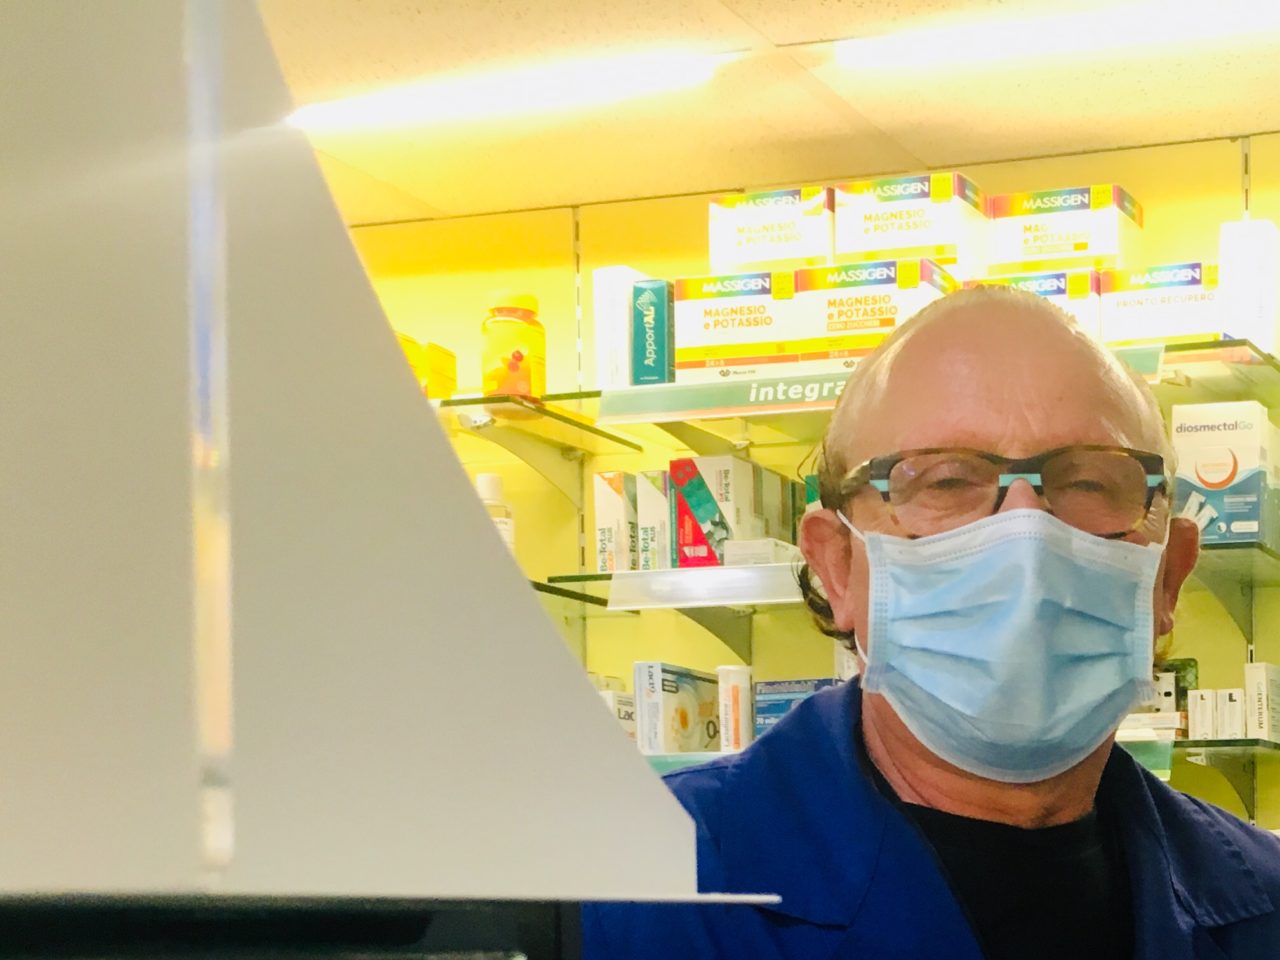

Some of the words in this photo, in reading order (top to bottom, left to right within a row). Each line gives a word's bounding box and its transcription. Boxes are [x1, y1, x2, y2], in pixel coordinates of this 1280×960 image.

[863, 181, 929, 198] MASSIGEN
[1022, 193, 1090, 210] MASSIGEN
[863, 207, 925, 223] MAGNESIO
[873, 220, 930, 233] POTASSIO
[827, 266, 896, 283] MASSIGEN
[1130, 267, 1201, 285] MASSIGEN
[702, 277, 771, 293] MASSIGEN
[1010, 277, 1066, 293] ASSIGEN
[827, 294, 891, 309] MAGNESIO
[703, 304, 767, 319] MAGNESIO
[827, 312, 835, 321] e
[836, 305, 898, 320] POTASSIO
[703, 322, 711, 331] e
[713, 316, 774, 330] POTASSIO
[643, 306, 658, 368] ApportAL
[1175, 420, 1254, 434] diosmectalGo
[598, 527, 608, 572] Be-Total
[640, 526, 650, 571] Be-Total
